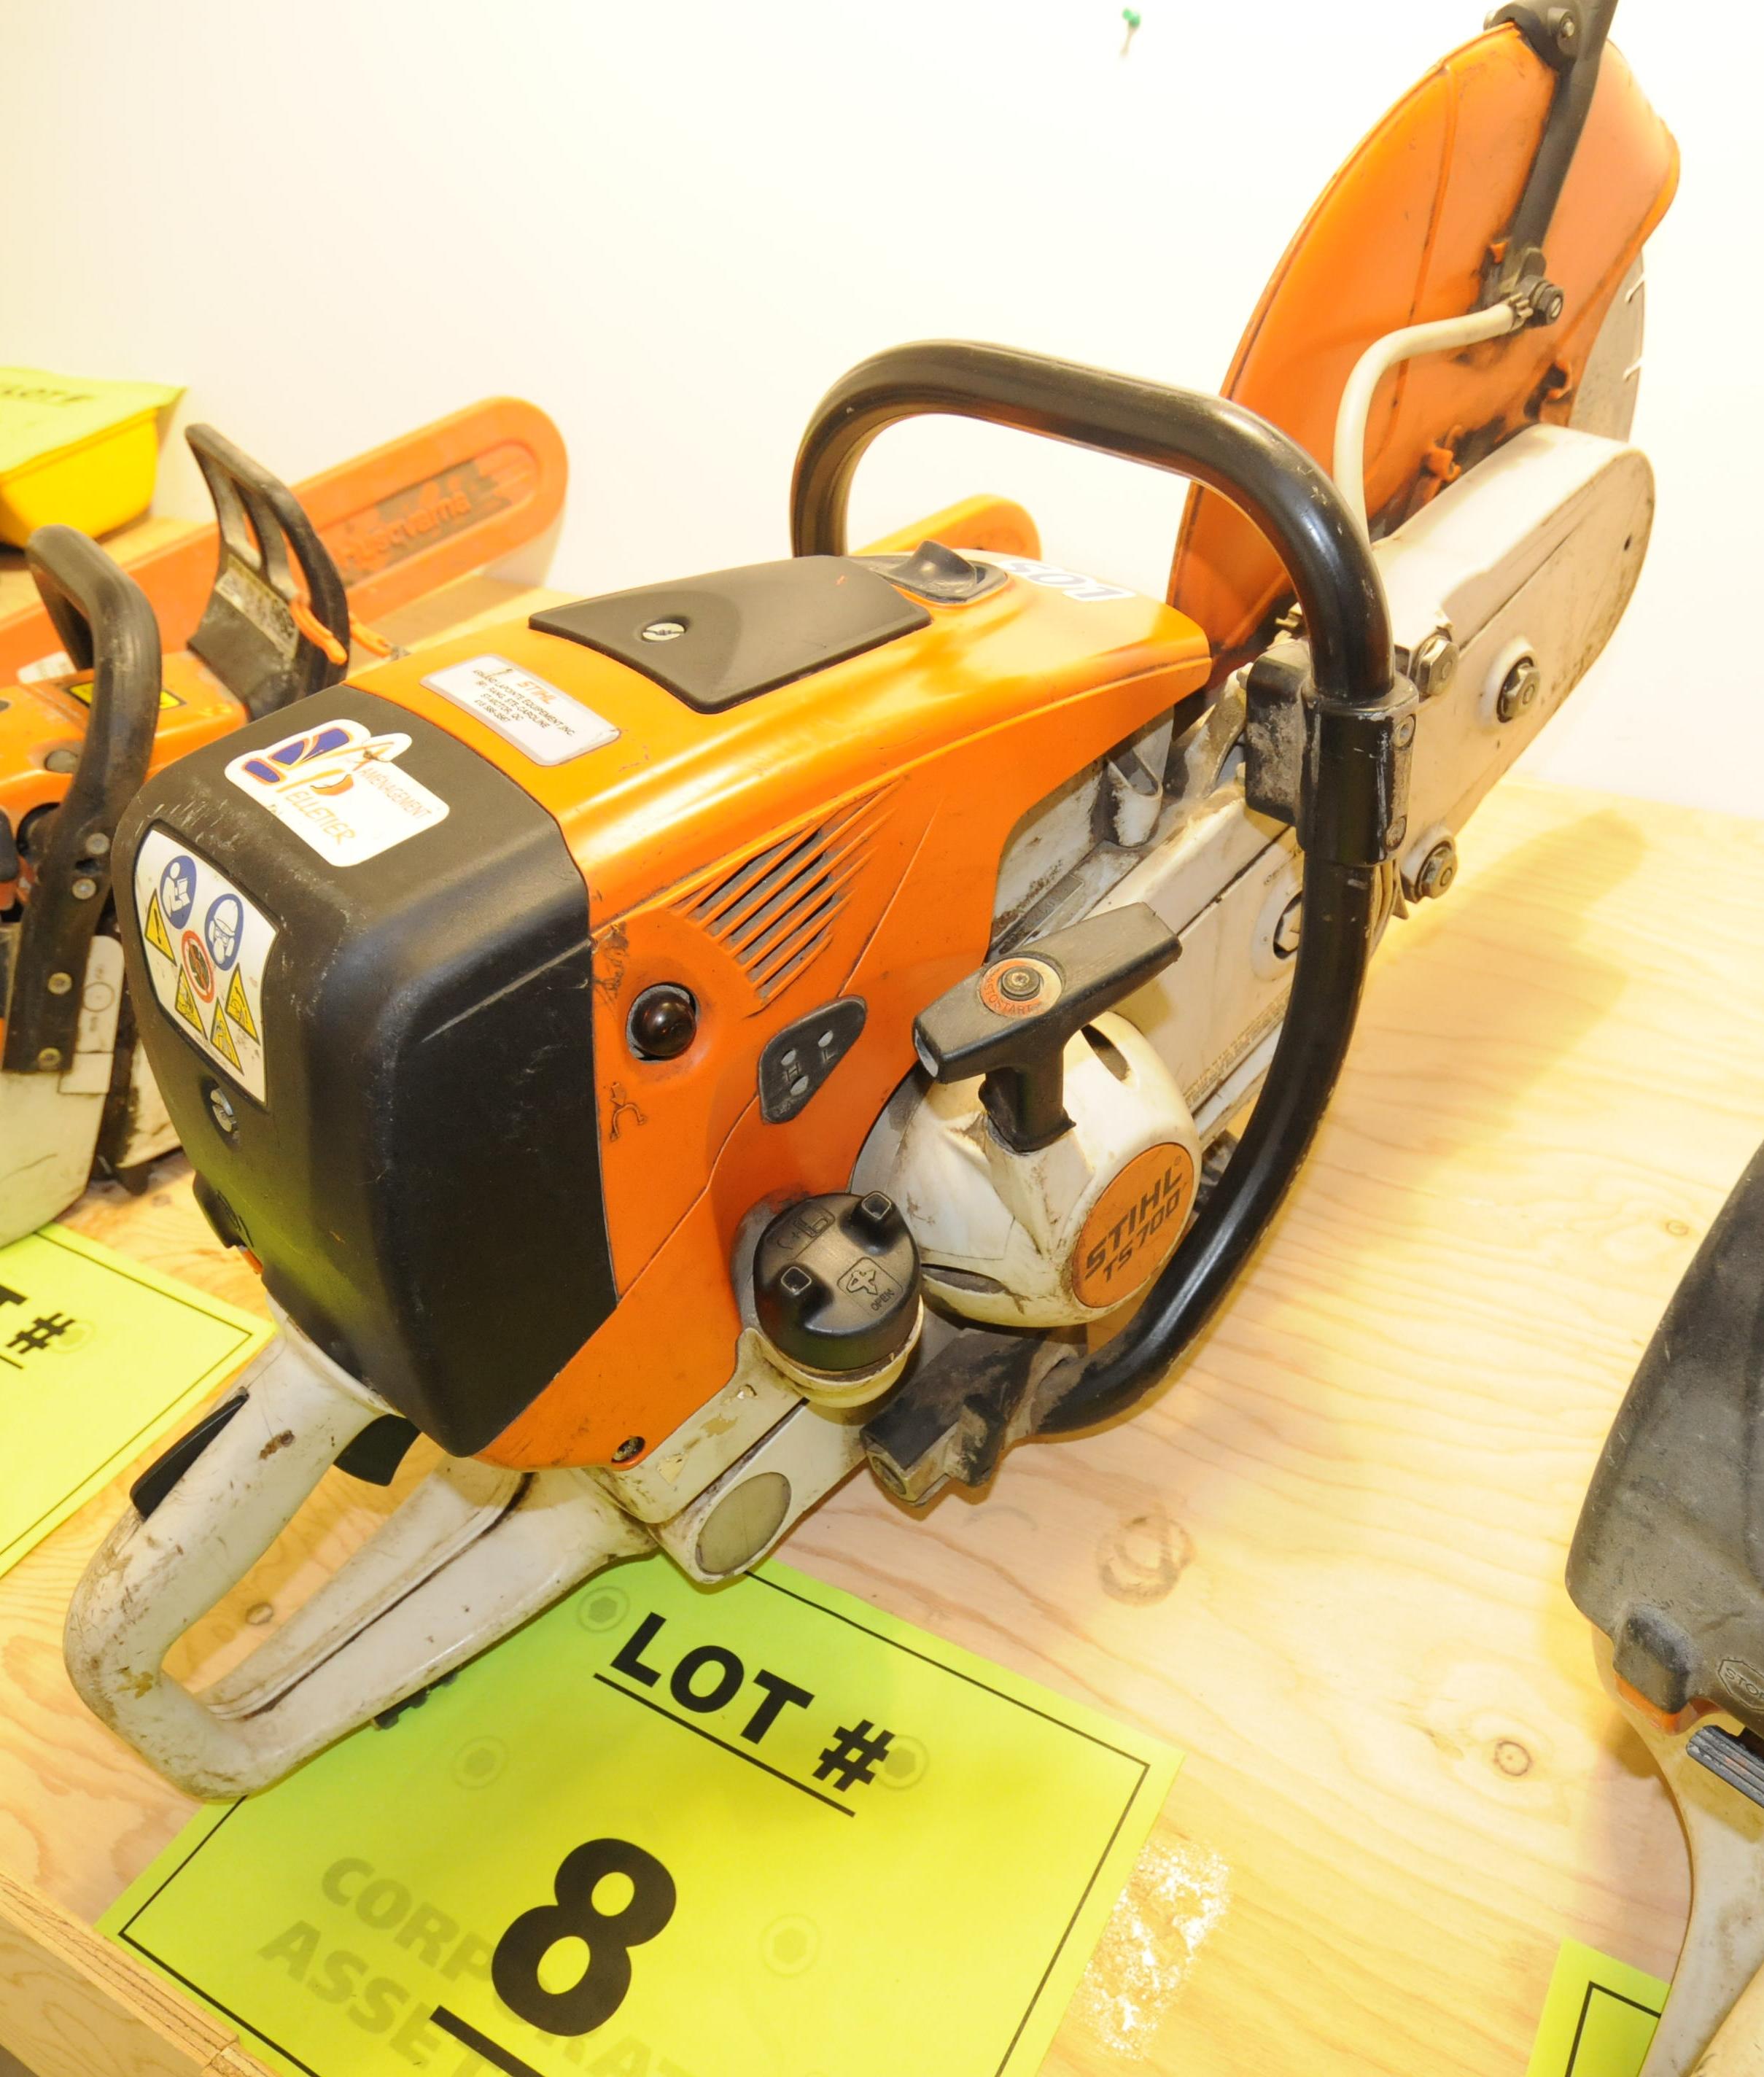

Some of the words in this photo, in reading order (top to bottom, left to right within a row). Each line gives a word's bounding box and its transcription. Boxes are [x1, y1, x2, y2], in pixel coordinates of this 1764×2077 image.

[1084, 1167, 1183, 1281] STIHL
[1103, 1239, 1133, 1283] TS
[1136, 1188, 1181, 1249] 700
[6, 1313, 76, 1354] #
[870, 1288, 895, 1311] OPEN
[610, 1611, 815, 1745] LOT
[812, 1718, 896, 1793] #
[491, 1837, 677, 2038] 8
